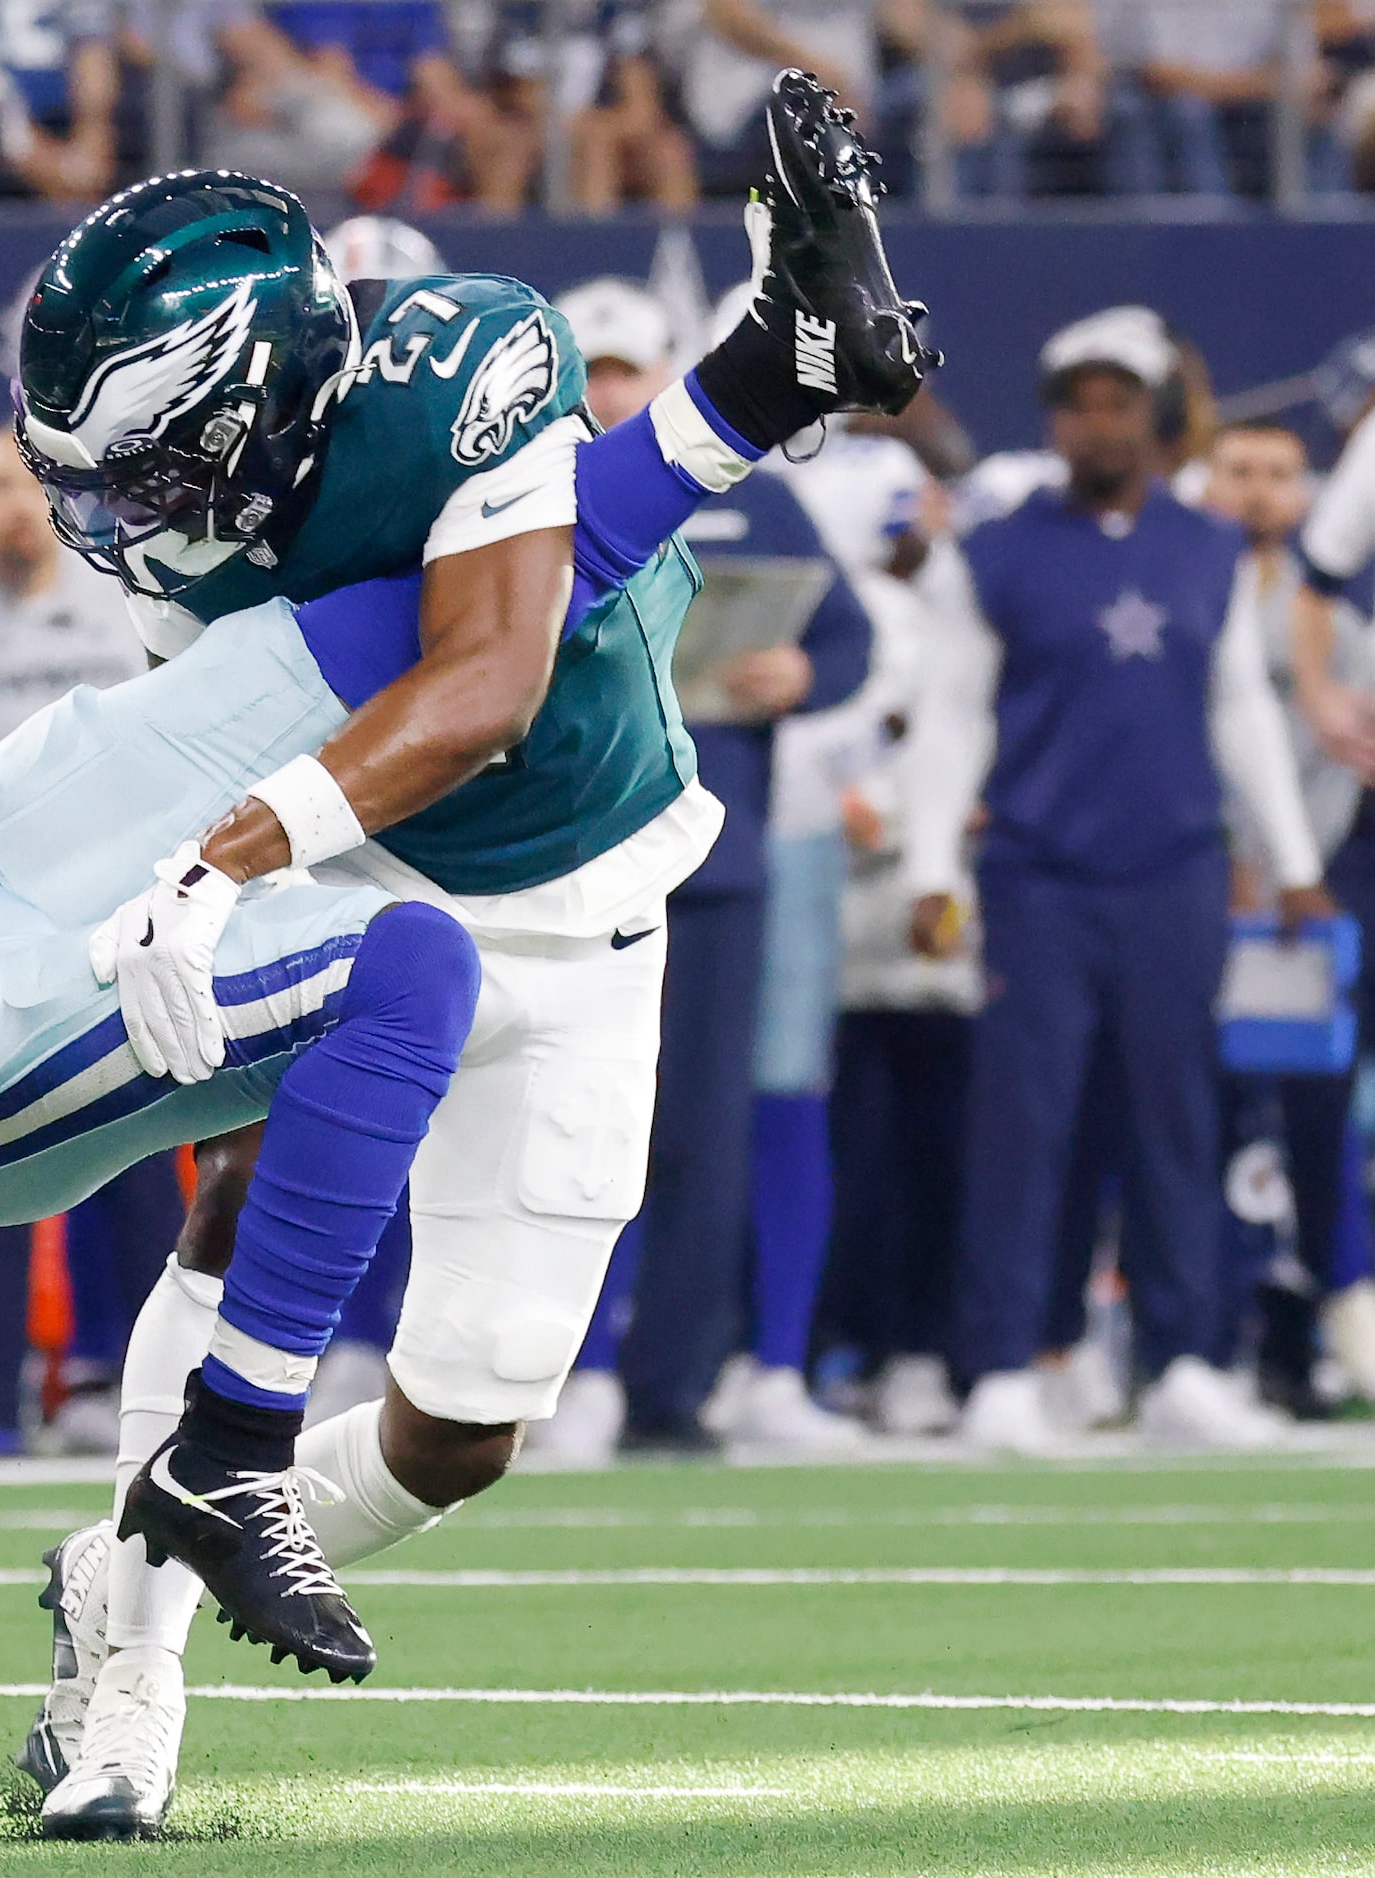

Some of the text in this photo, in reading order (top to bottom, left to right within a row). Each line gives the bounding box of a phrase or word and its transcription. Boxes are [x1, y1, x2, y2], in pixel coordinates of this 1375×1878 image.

[356, 288, 463, 384] 27
[794, 308, 839, 395] NIKE
[60, 1535, 110, 1622] NIKE
